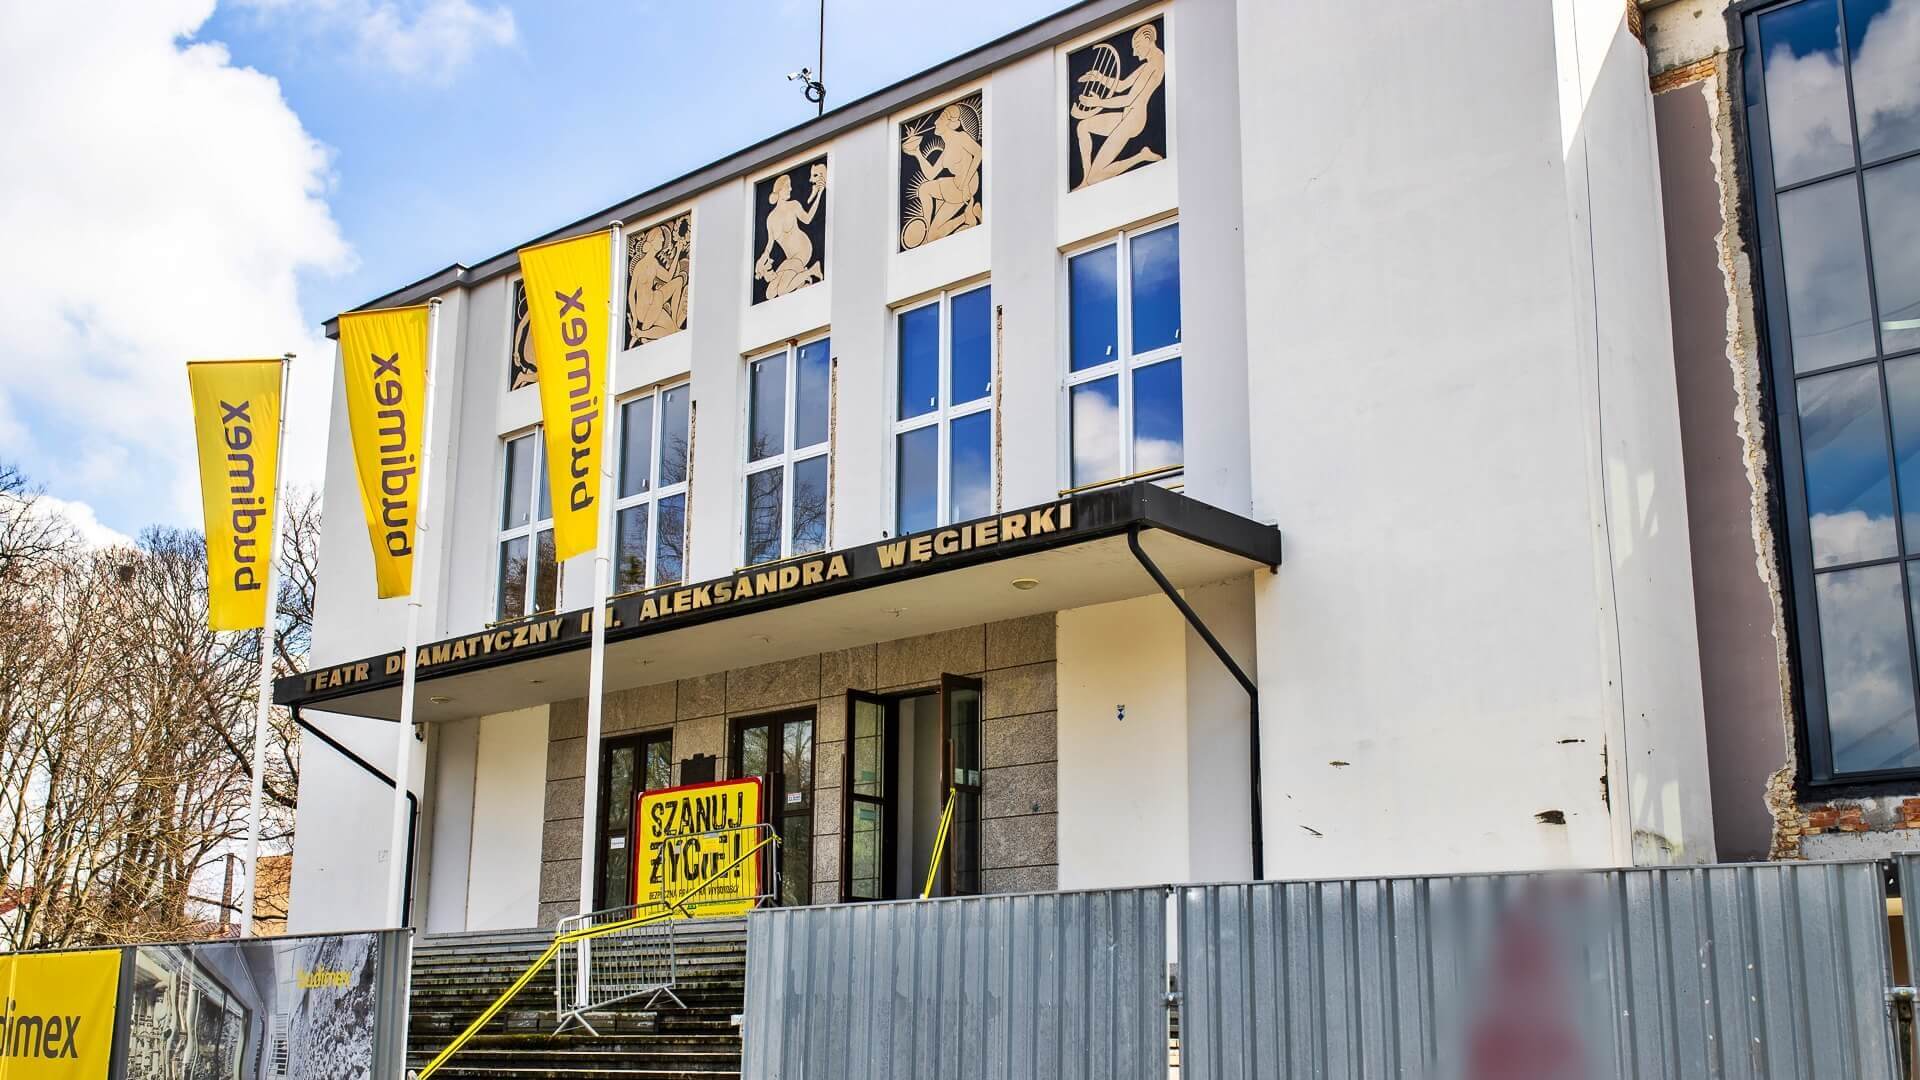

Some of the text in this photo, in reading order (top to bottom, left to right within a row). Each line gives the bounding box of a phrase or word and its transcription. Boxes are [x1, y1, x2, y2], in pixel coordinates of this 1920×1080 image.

[371, 352, 416, 558] budimex
[556, 286, 599, 512] budimex
[219, 400, 267, 592] budimex
[304, 663, 370, 693] TEATR
[386, 618, 563, 674] DAMATYCZNY
[639, 554, 849, 622] ALEKSANDRA
[877, 503, 1073, 563] WĘGIERKI
[649, 889, 677, 900] BEZPCZNA
[651, 791, 743, 837] SZANUJ
